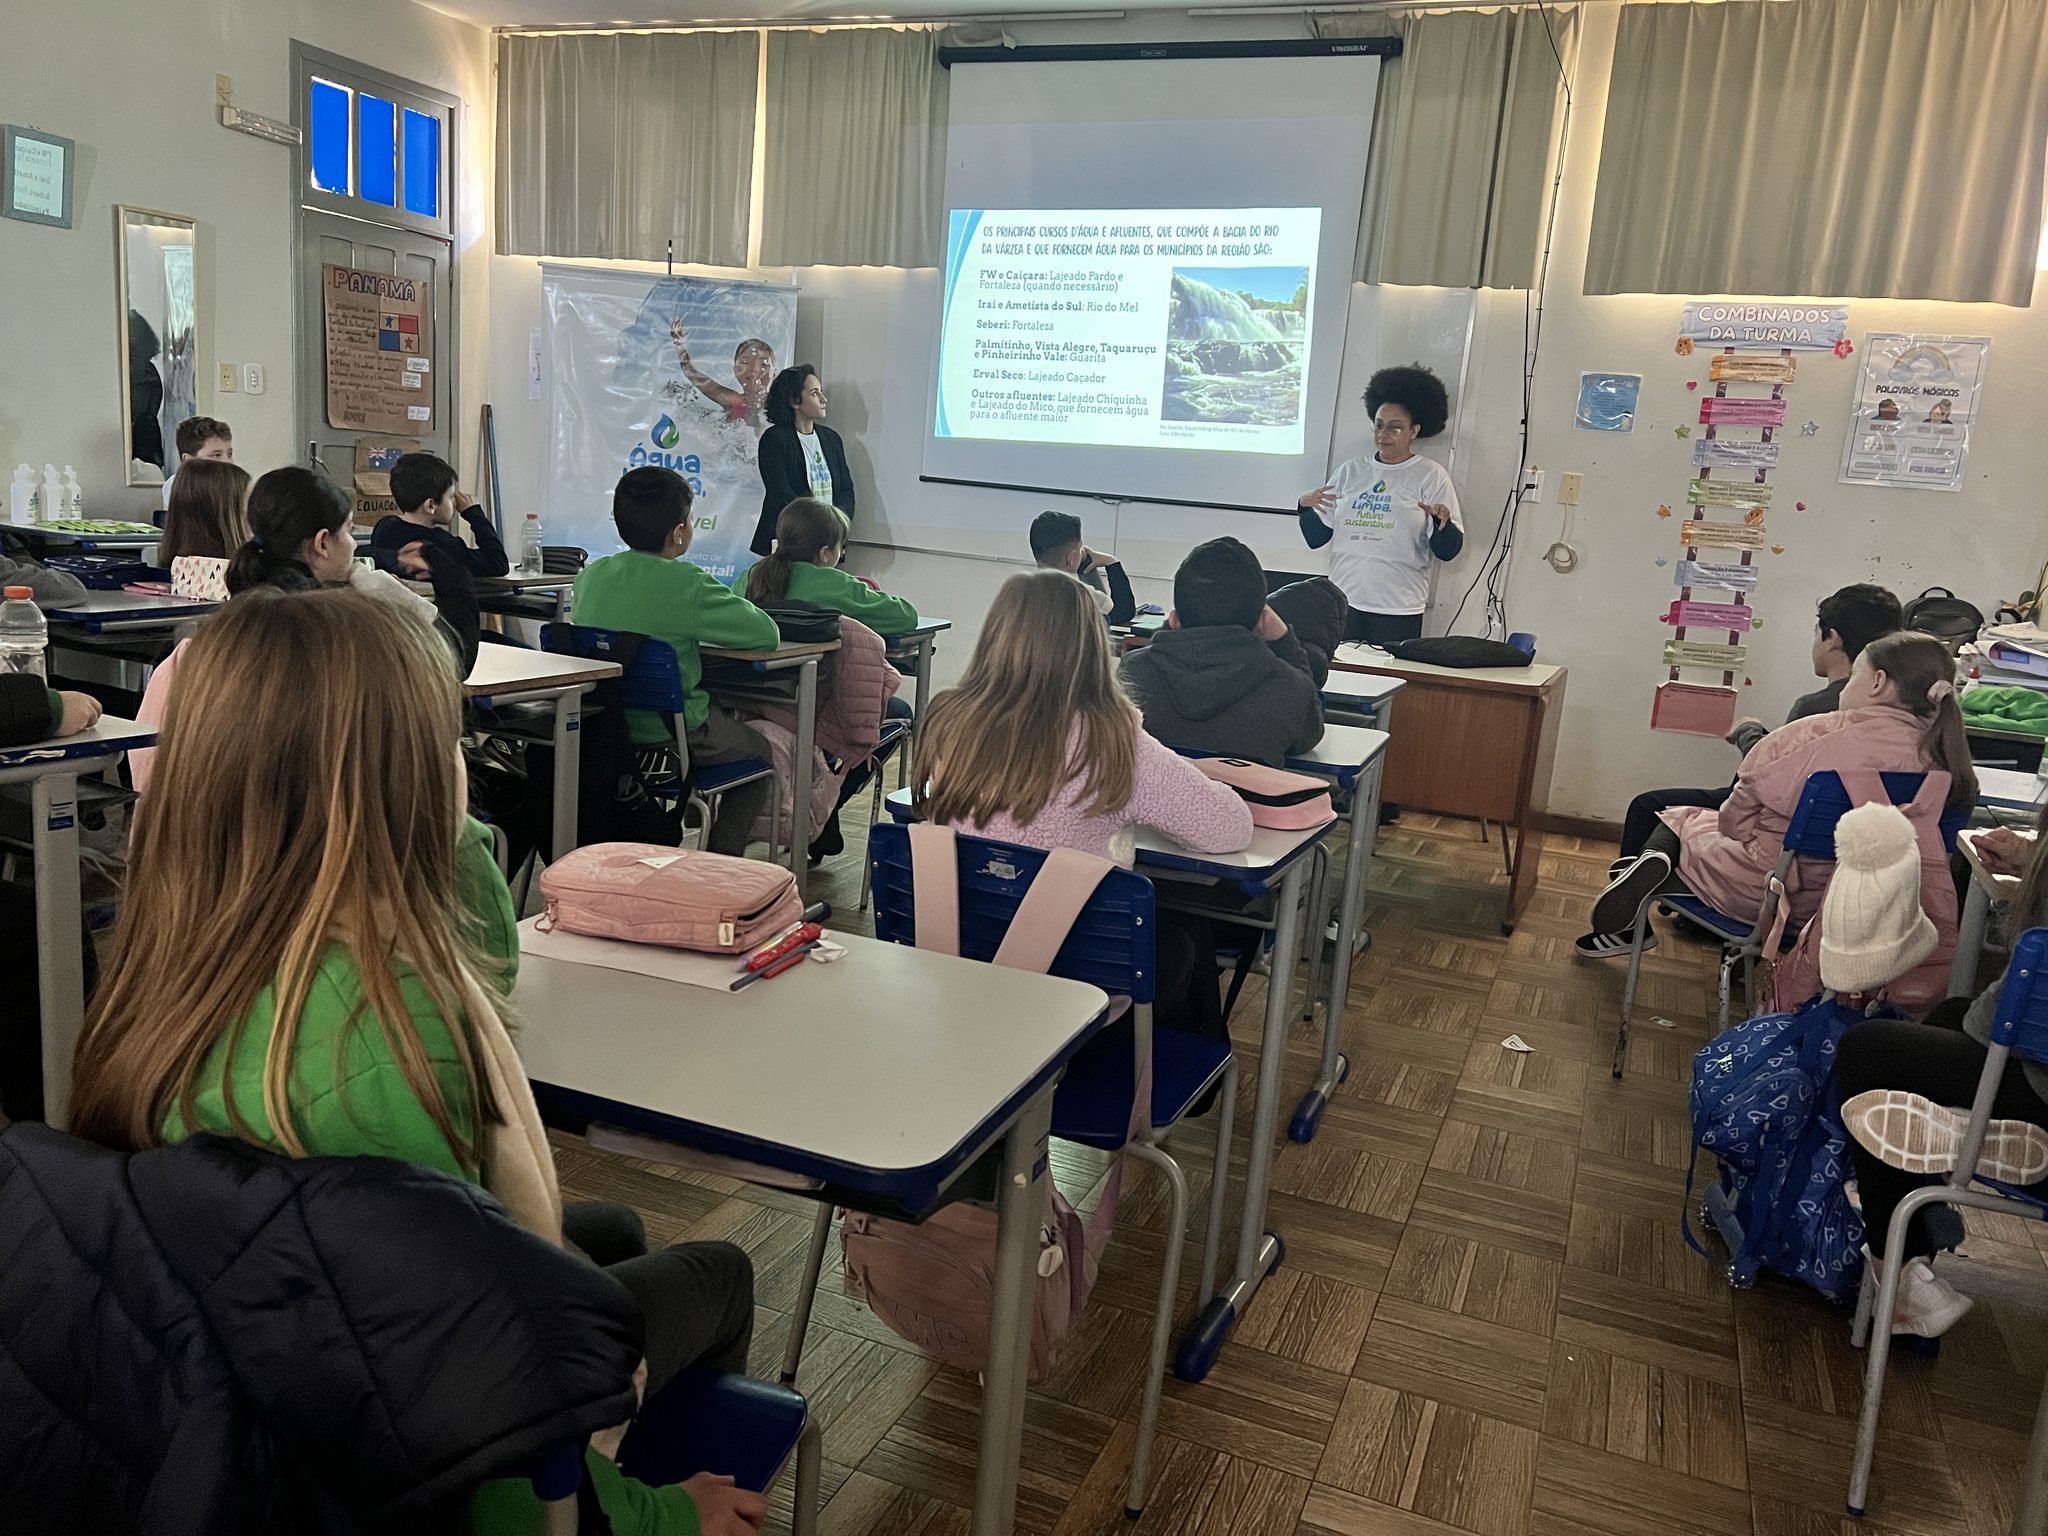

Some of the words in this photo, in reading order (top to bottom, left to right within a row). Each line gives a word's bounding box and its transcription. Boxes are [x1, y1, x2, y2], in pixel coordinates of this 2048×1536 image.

[983, 225, 994, 238] OS
[996, 225, 1037, 238] PRINCIPAIS
[1039, 225, 1069, 238] CURSOS
[1071, 223, 1099, 238] D'ÁGUA
[1102, 225, 1107, 238] E
[1109, 225, 1153, 239] AFLUENTES,
[1156, 225, 1173, 238] QUE
[1213, 225, 1220, 238] A
[1222, 225, 1247, 238] BACIA
[1249, 224, 1262, 237] DO
[1264, 224, 1279, 237] RIO
[981, 242, 993, 255] DA
[995, 241, 1024, 255] VÁRZEA
[1026, 243, 1032, 255] E
[1034, 242, 1050, 256] QUE
[1052, 243, 1093, 256] FORNECEM
[1095, 241, 1117, 256] ÁGUA
[1119, 243, 1140, 256] PARA
[1143, 243, 1154, 256] OS
[1156, 242, 1204, 256] MUNICÍPIOS
[1206, 244, 1218, 256] DA
[980, 269, 998, 280] FW
[998, 272, 1005, 280] e
[1006, 270, 1048, 282] Caiçara:
[1049, 270, 1087, 283] Lajeado
[1088, 271, 1116, 282] Pardo
[333, 266, 416, 302] PANAMÁ
[979, 280, 1021, 290] Fortaleza
[1023, 280, 1062, 292] (quando
[1063, 281, 1119, 293] necessário)
[997, 302, 1004, 310] e
[1005, 300, 1050, 311] Ametista
[1051, 301, 1064, 311] do
[1065, 301, 1085, 311] Sul:
[1086, 302, 1103, 312] Rio
[1104, 302, 1117, 312] do
[1118, 302, 1139, 312] Mel
[1698, 305, 1832, 324] COMBINADOS
[1012, 320, 1054, 331] Fortaleza
[1708, 326, 1737, 342] DA
[1742, 326, 1813, 343] TURMA
[975, 339, 1033, 353] Palmitinho,
[1034, 341, 1061, 352] Vista
[1062, 341, 1099, 354] Alegre,
[1100, 342, 1157, 355] Taquaruçu
[974, 351, 980, 359] e
[981, 350, 1042, 362] Pinheirinho
[1043, 352, 1068, 362] Vale:
[1069, 352, 1106, 363] Guarita
[972, 368, 999, 379] Erval
[1001, 370, 1026, 380] Seco:
[1028, 370, 1065, 383] Lajeado
[1066, 372, 1107, 384] Caçador
[971, 388, 1005, 399] Outros
[1006, 390, 1056, 402] afluentes:
[1057, 391, 1094, 405] Lajeado
[1096, 393, 1148, 406] Chiquinha
[1875, 384, 1920, 396] PALAVRAS
[1922, 385, 1960, 398] MÁGICAS
[978, 399, 1015, 411] Lajeado
[1015, 400, 1028, 411] do
[1029, 401, 1056, 413] Mico,
[1056, 404, 1076, 415] que
[1076, 402, 1124, 415] fornecem
[1125, 405, 1149, 418] água
[970, 411, 990, 421] para
[991, 412, 998, 420] o
[999, 410, 1039, 422] afluente
[1040, 412, 1070, 423] maior
[629, 442, 701, 474] Água
[1359, 490, 1392, 503] Água
[1356, 509, 1384, 521] futuro
